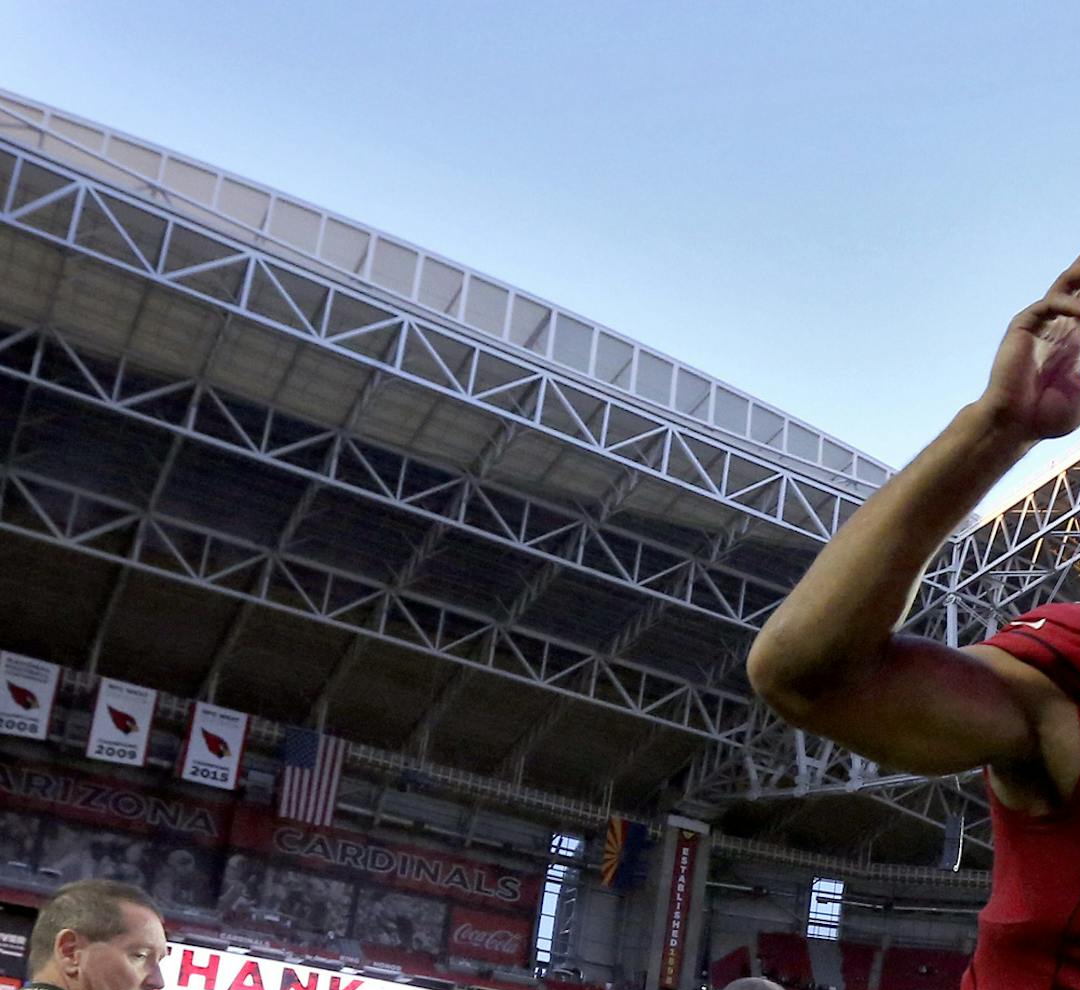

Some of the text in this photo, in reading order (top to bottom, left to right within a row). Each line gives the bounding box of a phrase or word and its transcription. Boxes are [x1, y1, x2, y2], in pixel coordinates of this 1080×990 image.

[94, 744, 138, 760] 2009
[189, 765, 229, 783] 2015
[272, 827, 521, 901] CARDINALS
[669, 847, 690, 947] ESTABLISHED
